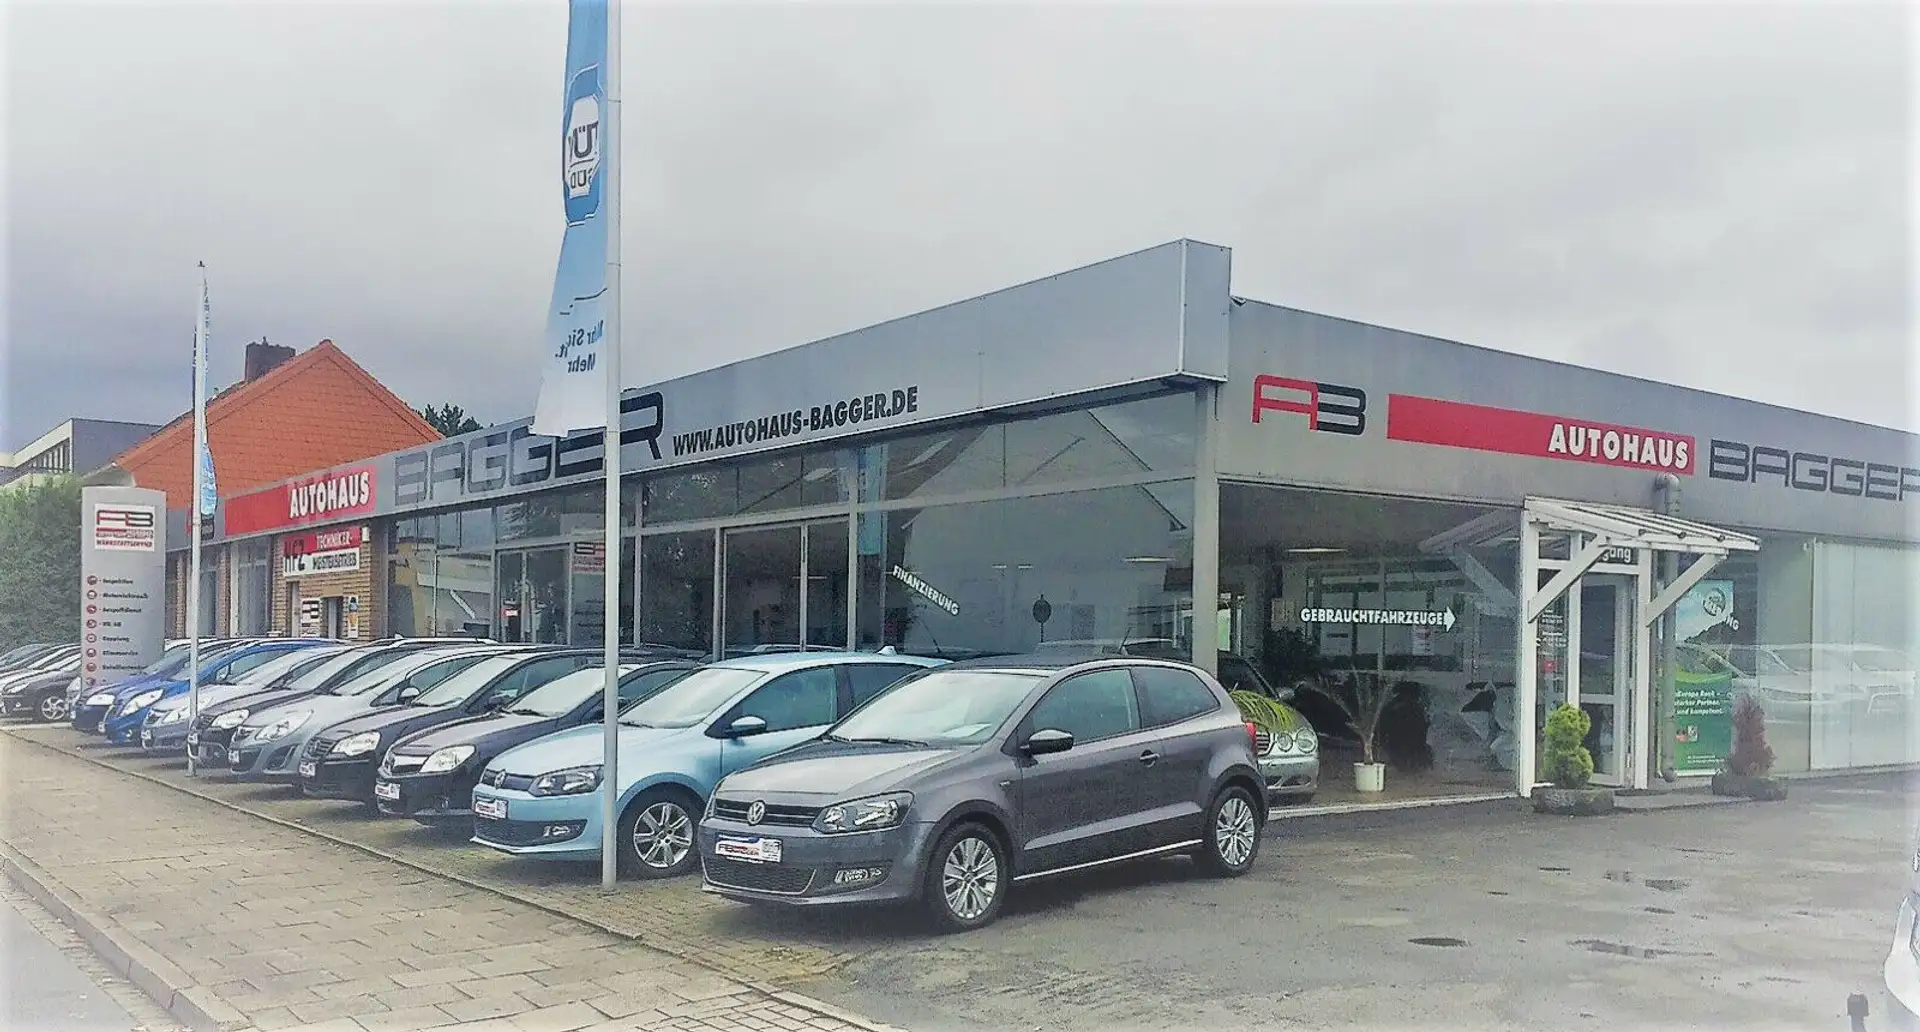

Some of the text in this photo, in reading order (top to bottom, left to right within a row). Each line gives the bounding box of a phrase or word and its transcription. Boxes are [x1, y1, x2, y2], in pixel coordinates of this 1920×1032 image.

[673, 386, 918, 457] WWW.AUTOHAUS-BAGGER.DE
[1548, 423, 1690, 469] AUTOHAUS
[395, 391, 664, 505] BAGGER
[289, 471, 370, 519] AUTOHAUS
[893, 564, 959, 616] FINANZIERUNG
[1301, 607, 1443, 626] GEBRAUCHTFAHRZEUGE
